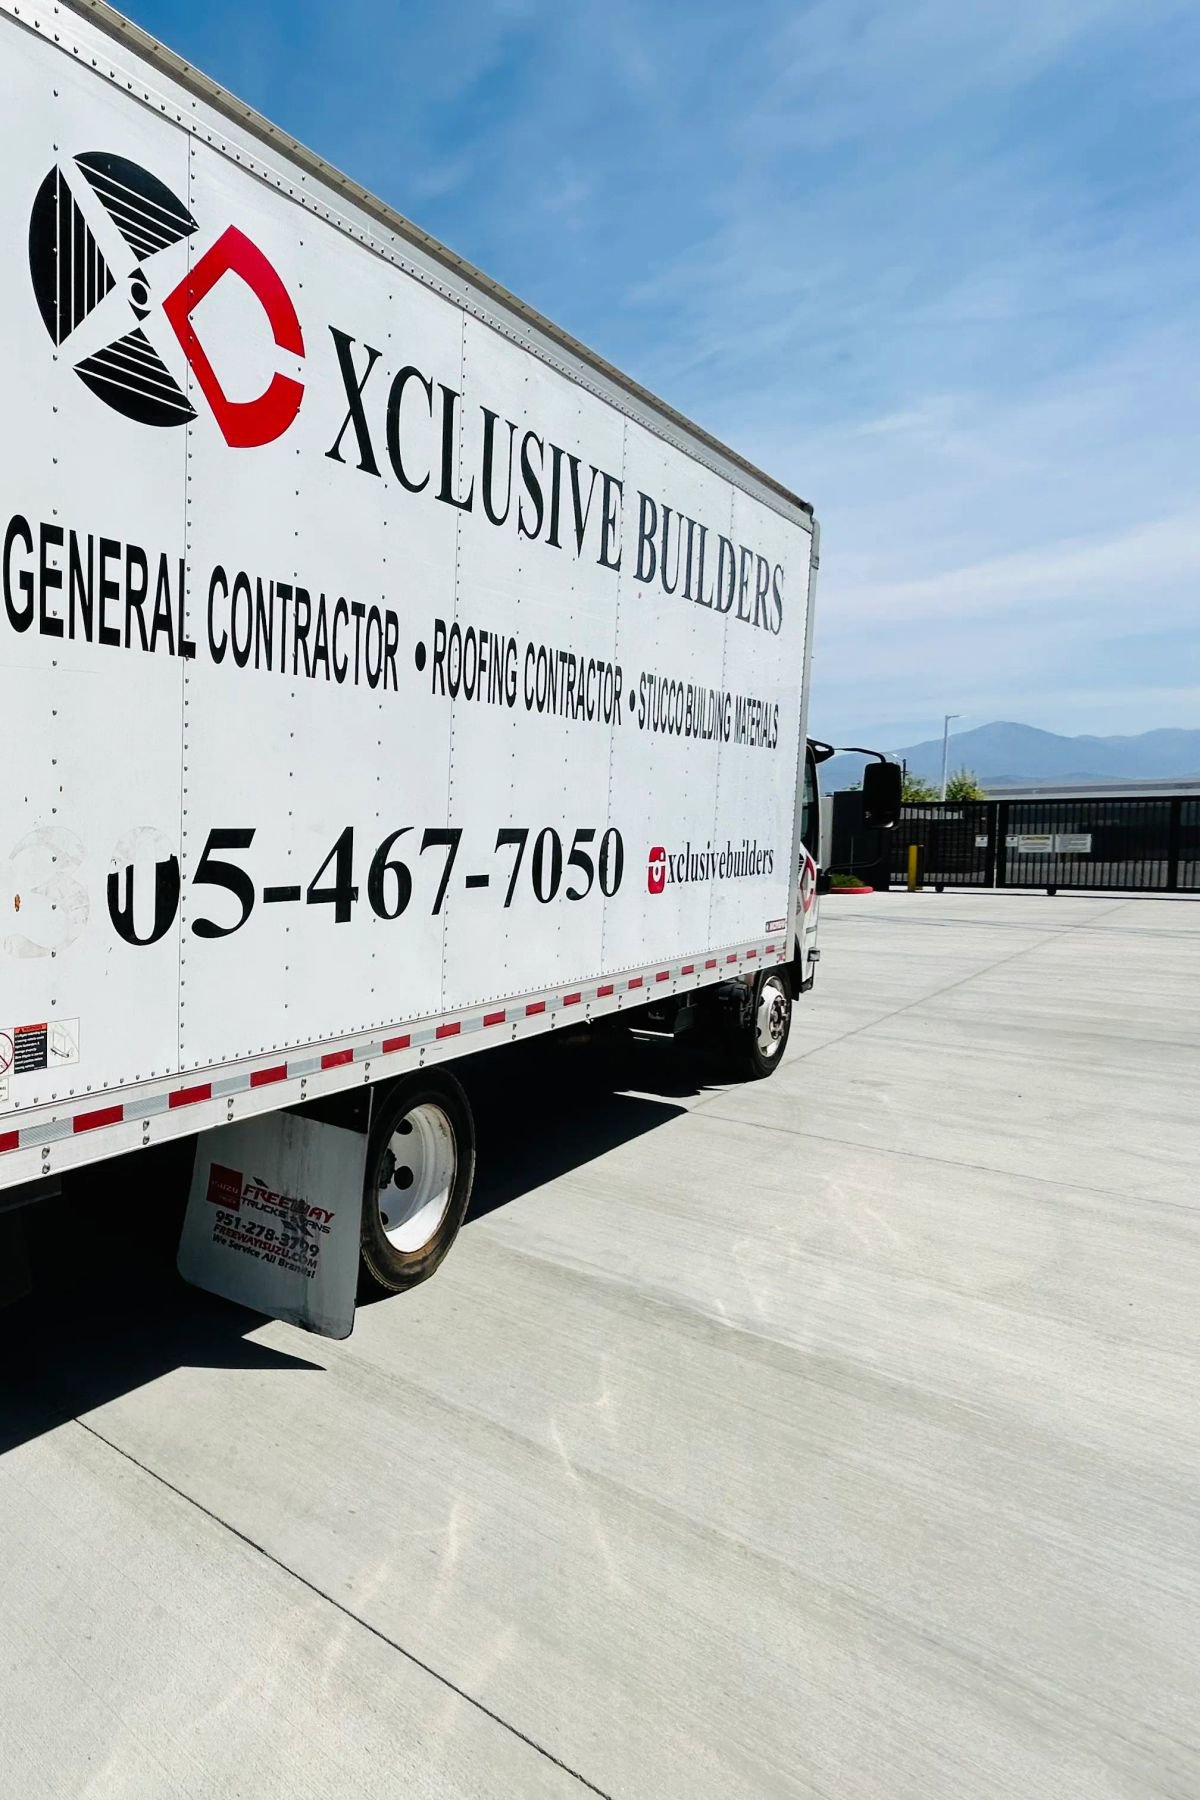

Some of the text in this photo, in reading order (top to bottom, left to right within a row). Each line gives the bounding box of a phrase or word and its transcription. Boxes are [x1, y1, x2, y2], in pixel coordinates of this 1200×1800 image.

[324, 325, 785, 636] XCLUSIVE BUILDERS
[2, 514, 779, 750] GENERAL CONTRACTOR ROOFING CONTRACTOR STUCCO BUILDING MATERIALS
[666, 839, 774, 884] xclusivebuilders
[241, 1197, 289, 1218] TRUCKS
[213, 1224, 318, 1269] FREEWAYISUZU.COM
[213, 1233, 226, 1245] We
[228, 1239, 260, 1259] Service
[261, 1252, 276, 1264] All
